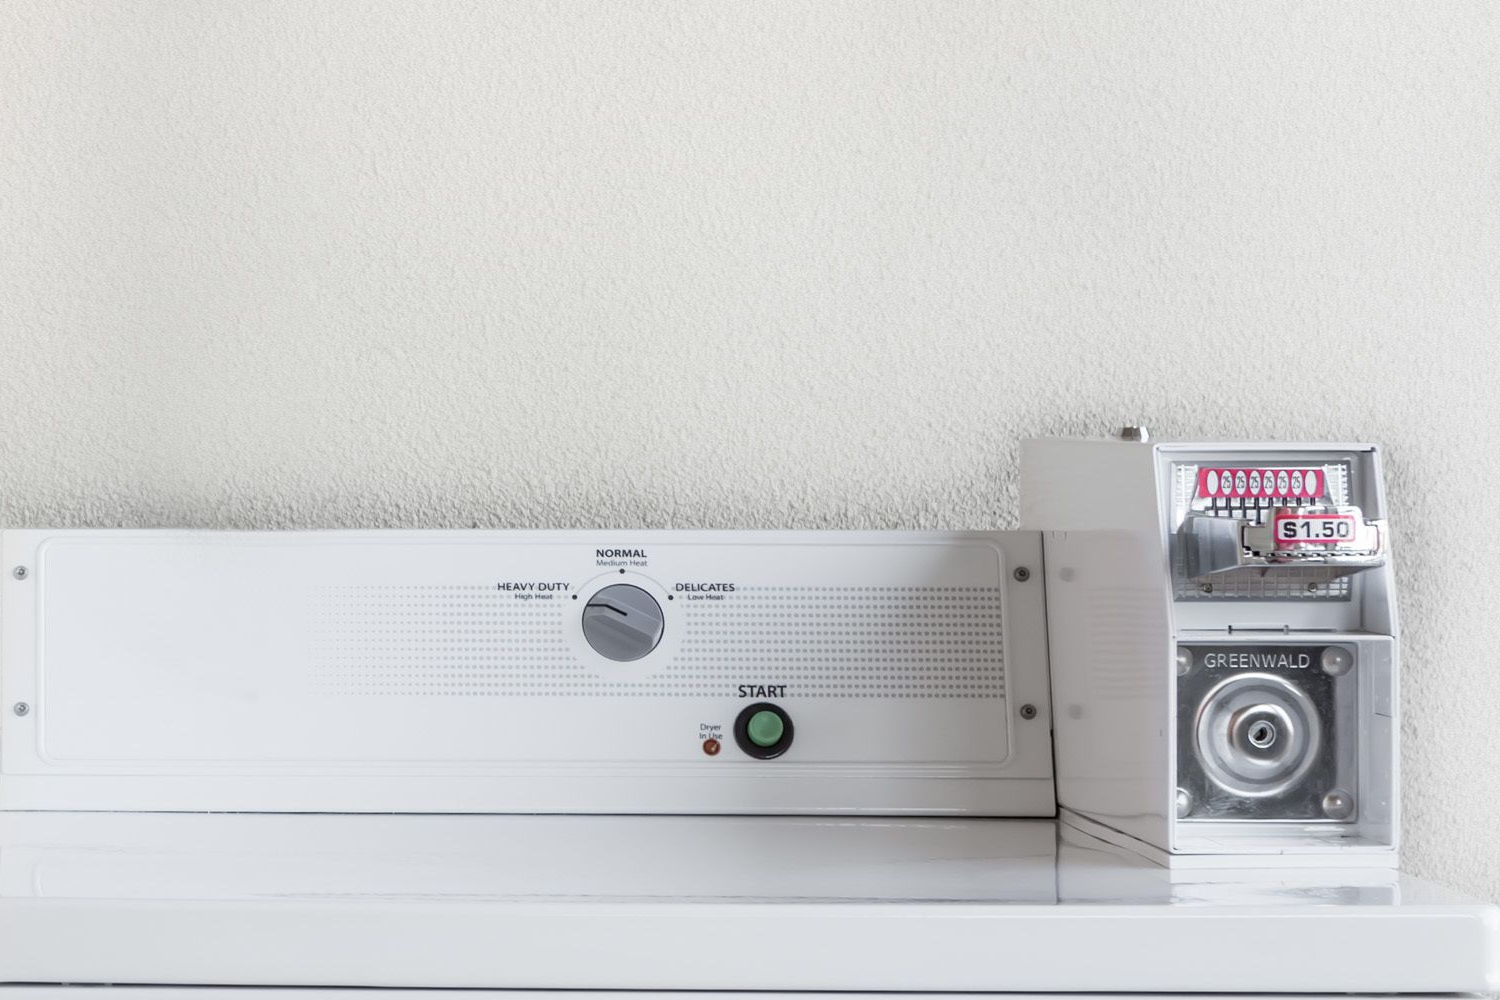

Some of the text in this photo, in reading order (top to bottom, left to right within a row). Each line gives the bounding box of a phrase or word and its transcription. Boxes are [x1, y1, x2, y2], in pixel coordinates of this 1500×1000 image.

[1222, 476, 1301, 488] 25 25 25 25 25 25
[1283, 522, 1350, 538] $1.50
[596, 549, 648, 558] NORMAL
[497, 582, 570, 591] HEAVY DUTY
[675, 583, 736, 592] DELICATES
[514, 593, 532, 601] High
[1204, 653, 1310, 669] GREENWALD
[738, 685, 787, 698] START
[700, 723, 722, 731] Dryer
